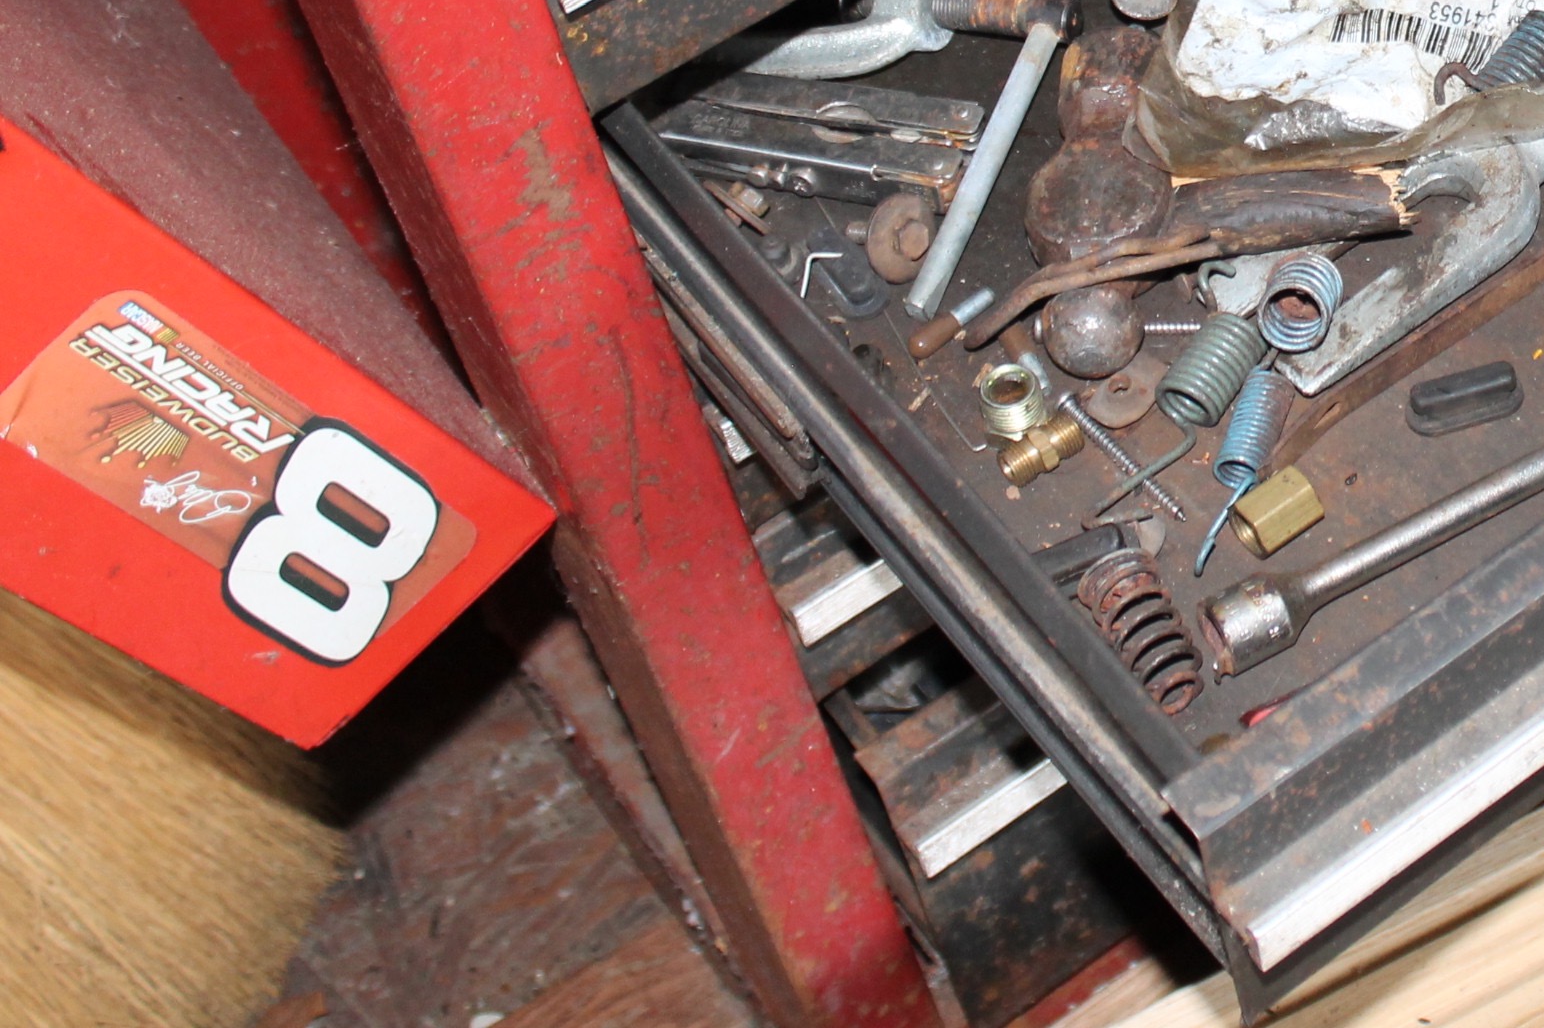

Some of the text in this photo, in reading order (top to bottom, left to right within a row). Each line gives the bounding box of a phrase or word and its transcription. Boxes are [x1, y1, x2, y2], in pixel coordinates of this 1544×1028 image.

[1429, 1, 1497, 32] 341953
[119, 301, 164, 334] NASCAR
[69, 338, 260, 463] BUDWEISER
[85, 324, 295, 455] RACING
[176, 341, 244, 390] OFFICIAL BEER
[225, 424, 438, 664] 8
